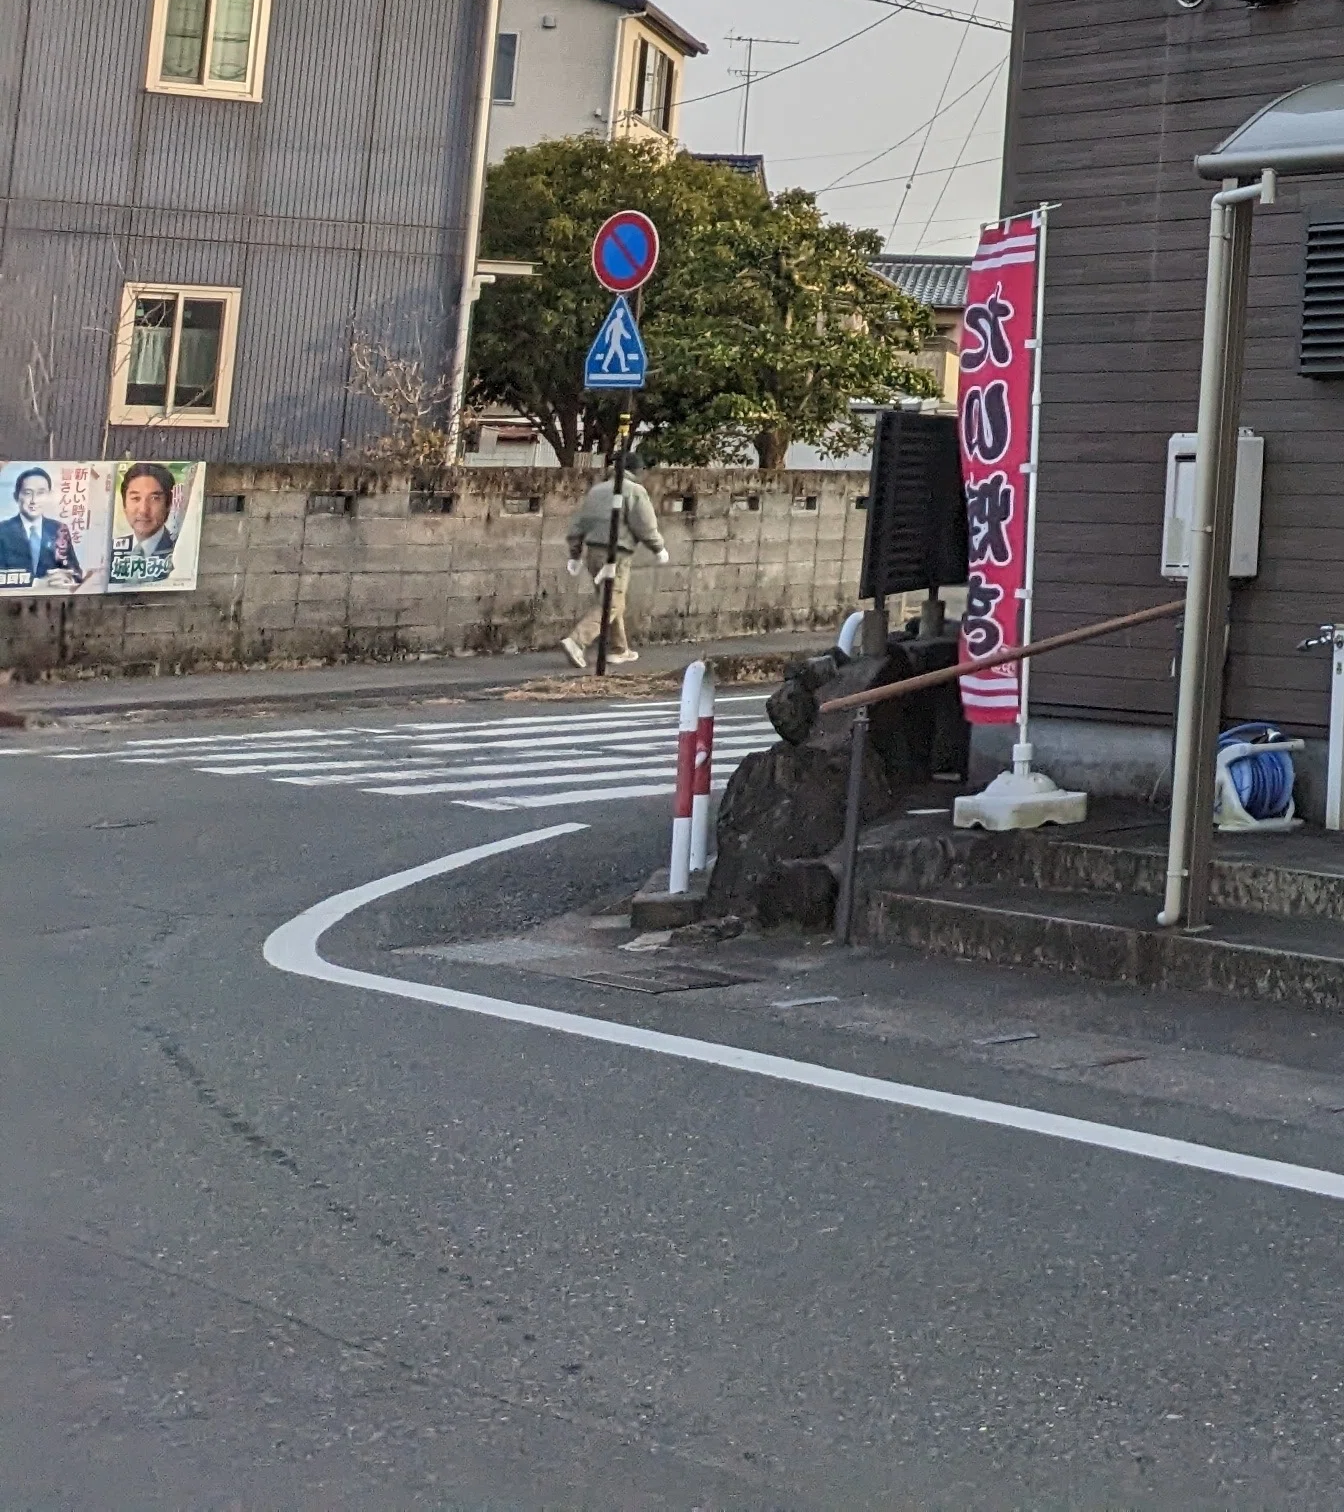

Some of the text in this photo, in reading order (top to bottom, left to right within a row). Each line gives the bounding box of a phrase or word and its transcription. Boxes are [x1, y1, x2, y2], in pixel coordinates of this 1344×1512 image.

[71, 467, 88, 544] 新しい時代を
